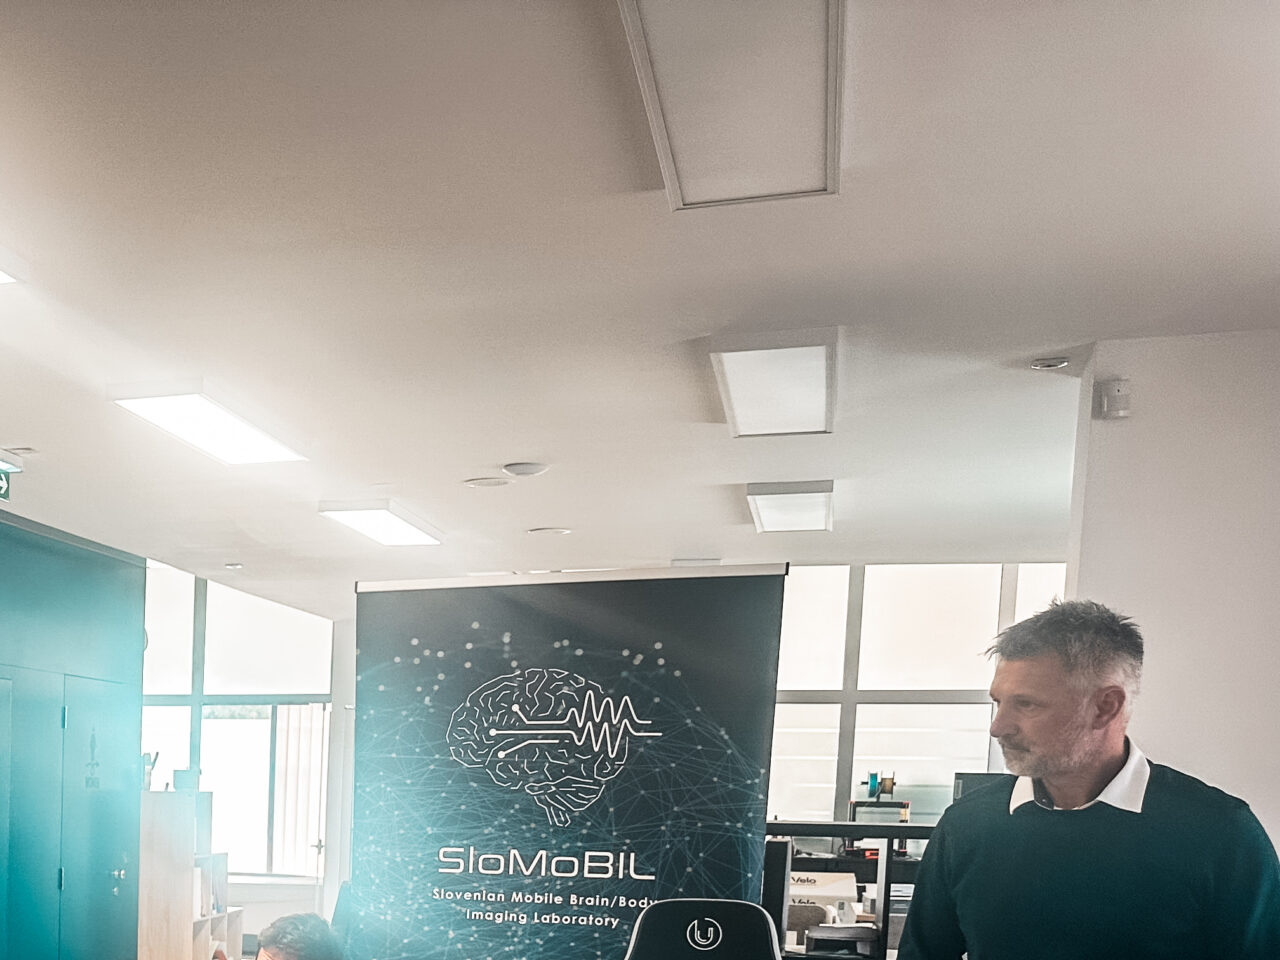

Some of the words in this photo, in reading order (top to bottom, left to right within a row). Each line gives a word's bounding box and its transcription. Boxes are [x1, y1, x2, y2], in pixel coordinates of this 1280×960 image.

[432, 888, 505, 902] Slovenian
[511, 891, 563, 904] Mobile
[466, 909, 527, 925] Imaging
[534, 912, 619, 929] Laboratory
